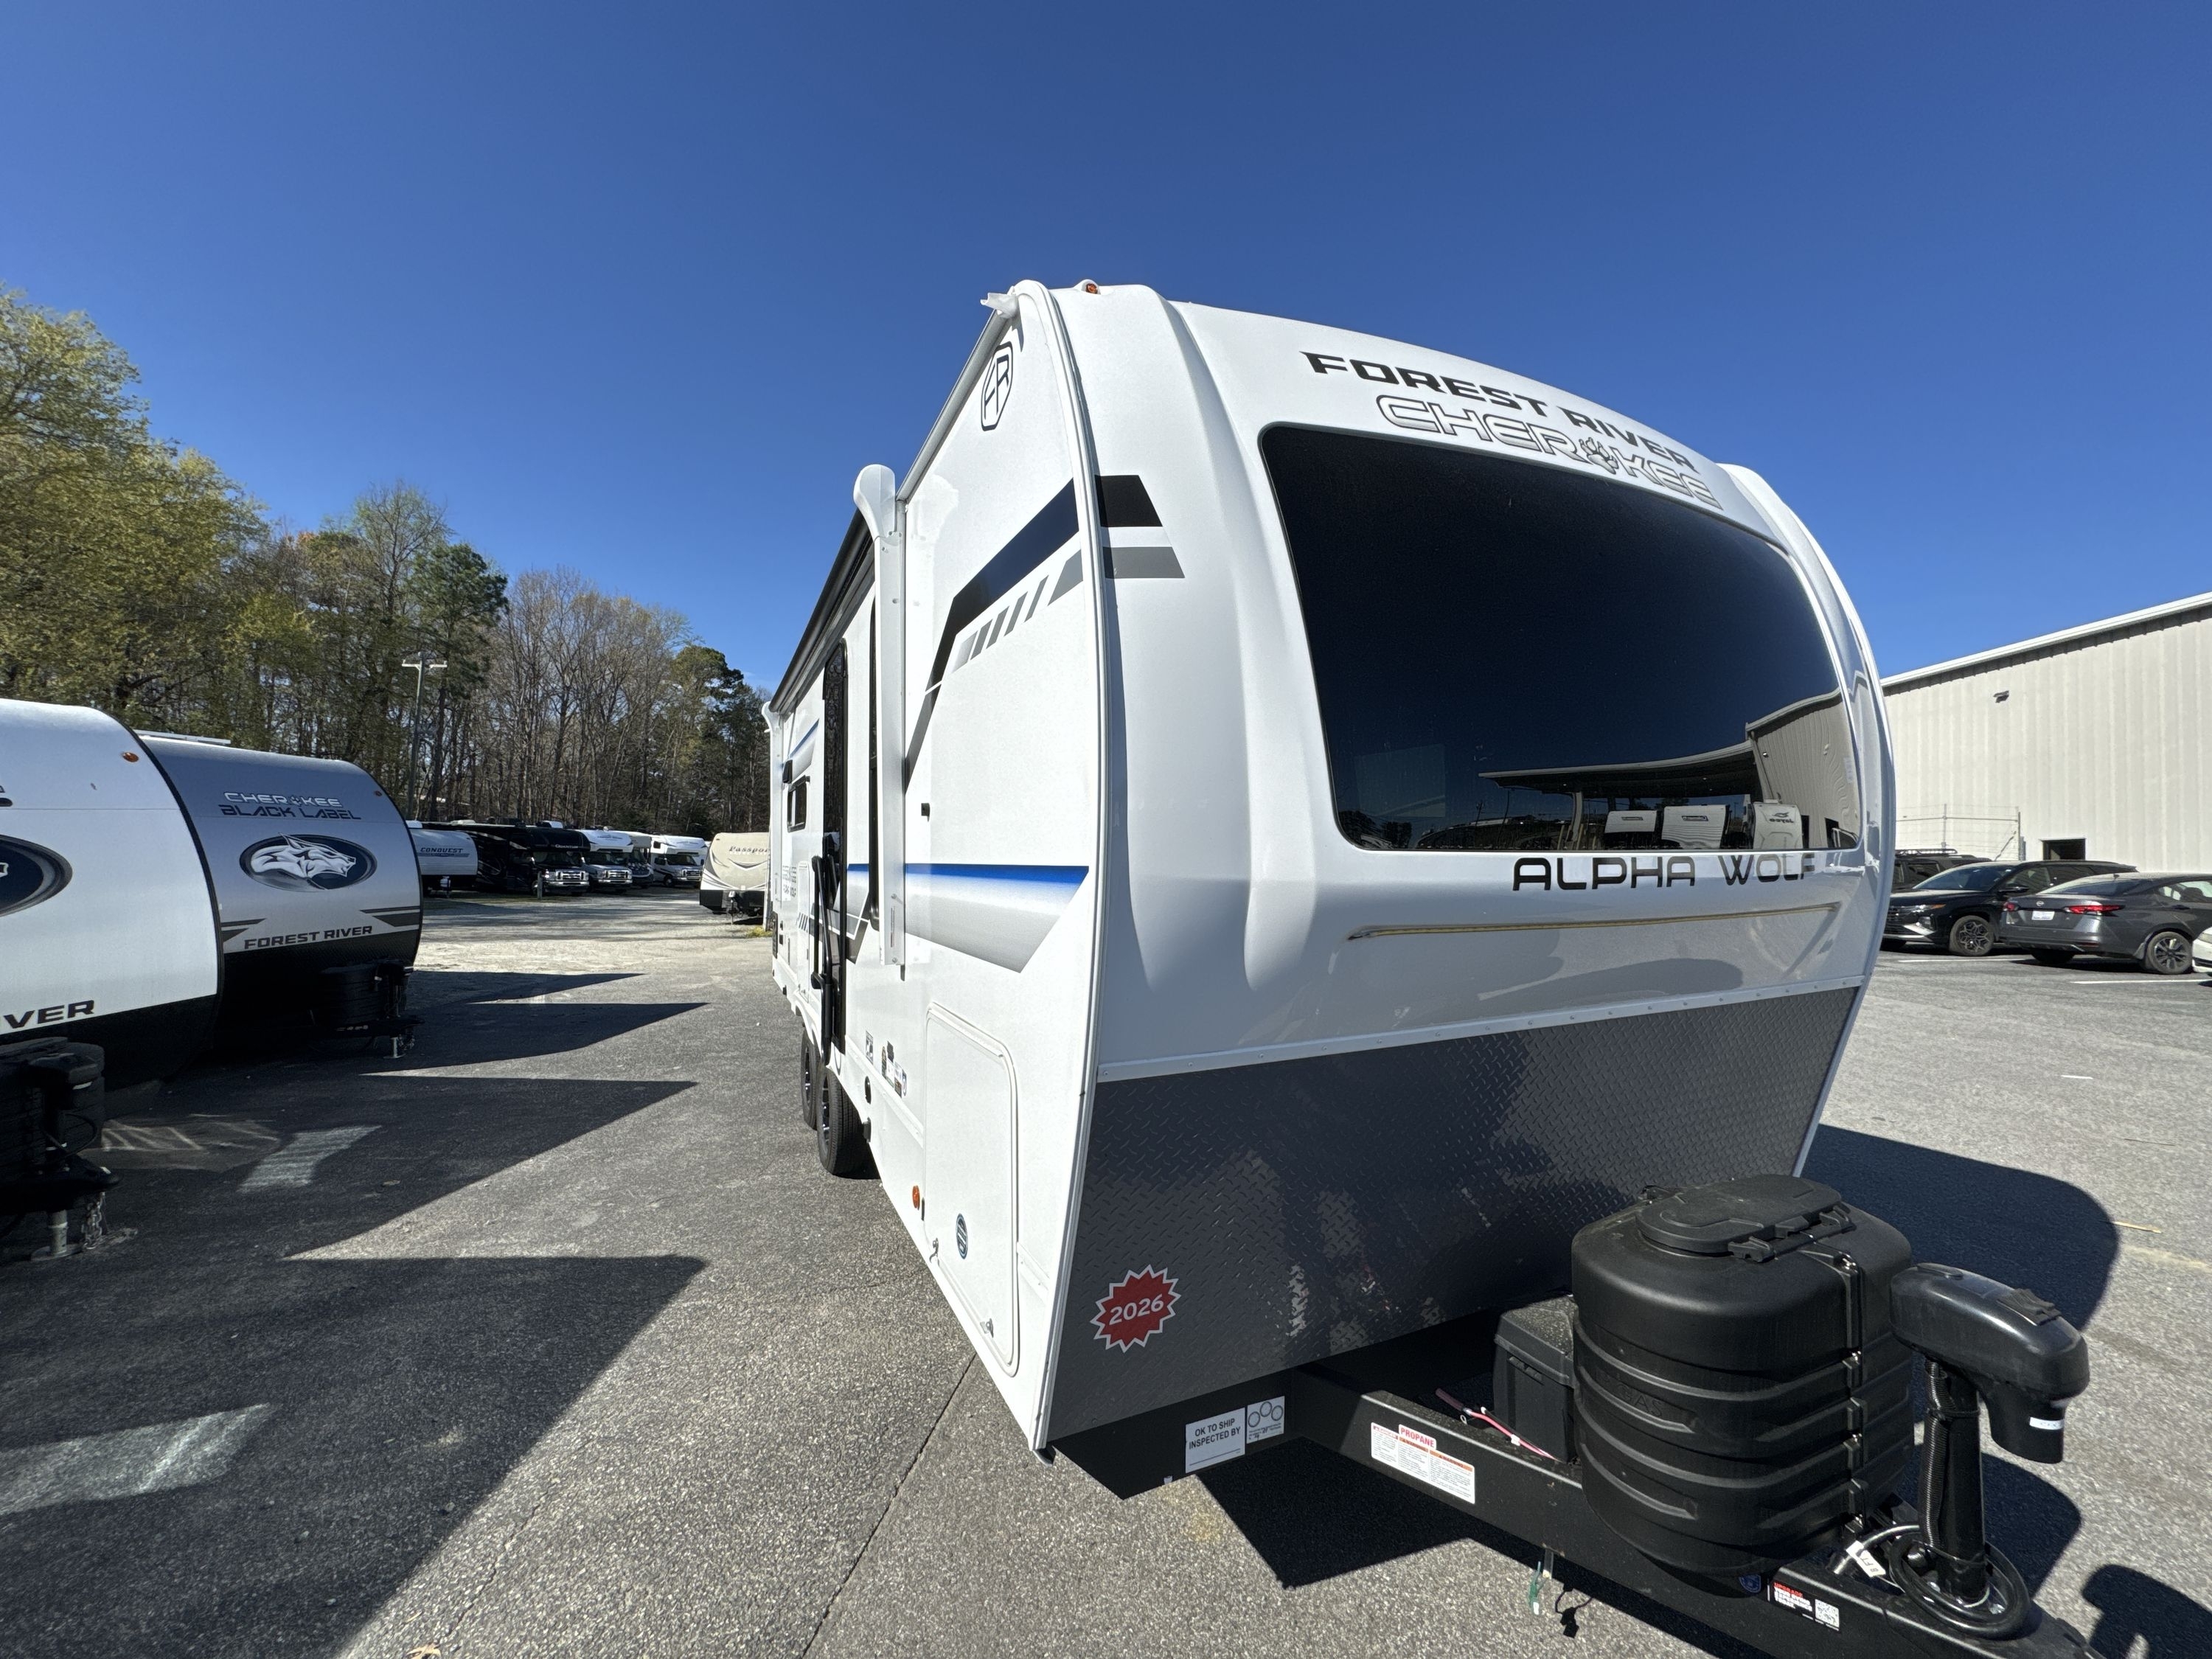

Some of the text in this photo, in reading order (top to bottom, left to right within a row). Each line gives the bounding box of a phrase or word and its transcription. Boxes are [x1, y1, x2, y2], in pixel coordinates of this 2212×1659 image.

[1298, 351, 1700, 474] FOREST RIVER
[218, 804, 361, 820] BLACK LABEL
[1512, 852, 1815, 891] ALPHA WOLF
[244, 925, 372, 949] FOREST RIVER
[2, 1000, 94, 1029] VER
[1109, 1293, 1164, 1325] 2026
[1189, 1430, 1229, 1449] INSPECTED
[1231, 1427, 1241, 1436] BY
[1194, 1418, 1235, 1437] OK TO SHIP
[1401, 1427, 1434, 1448] PROPANE
